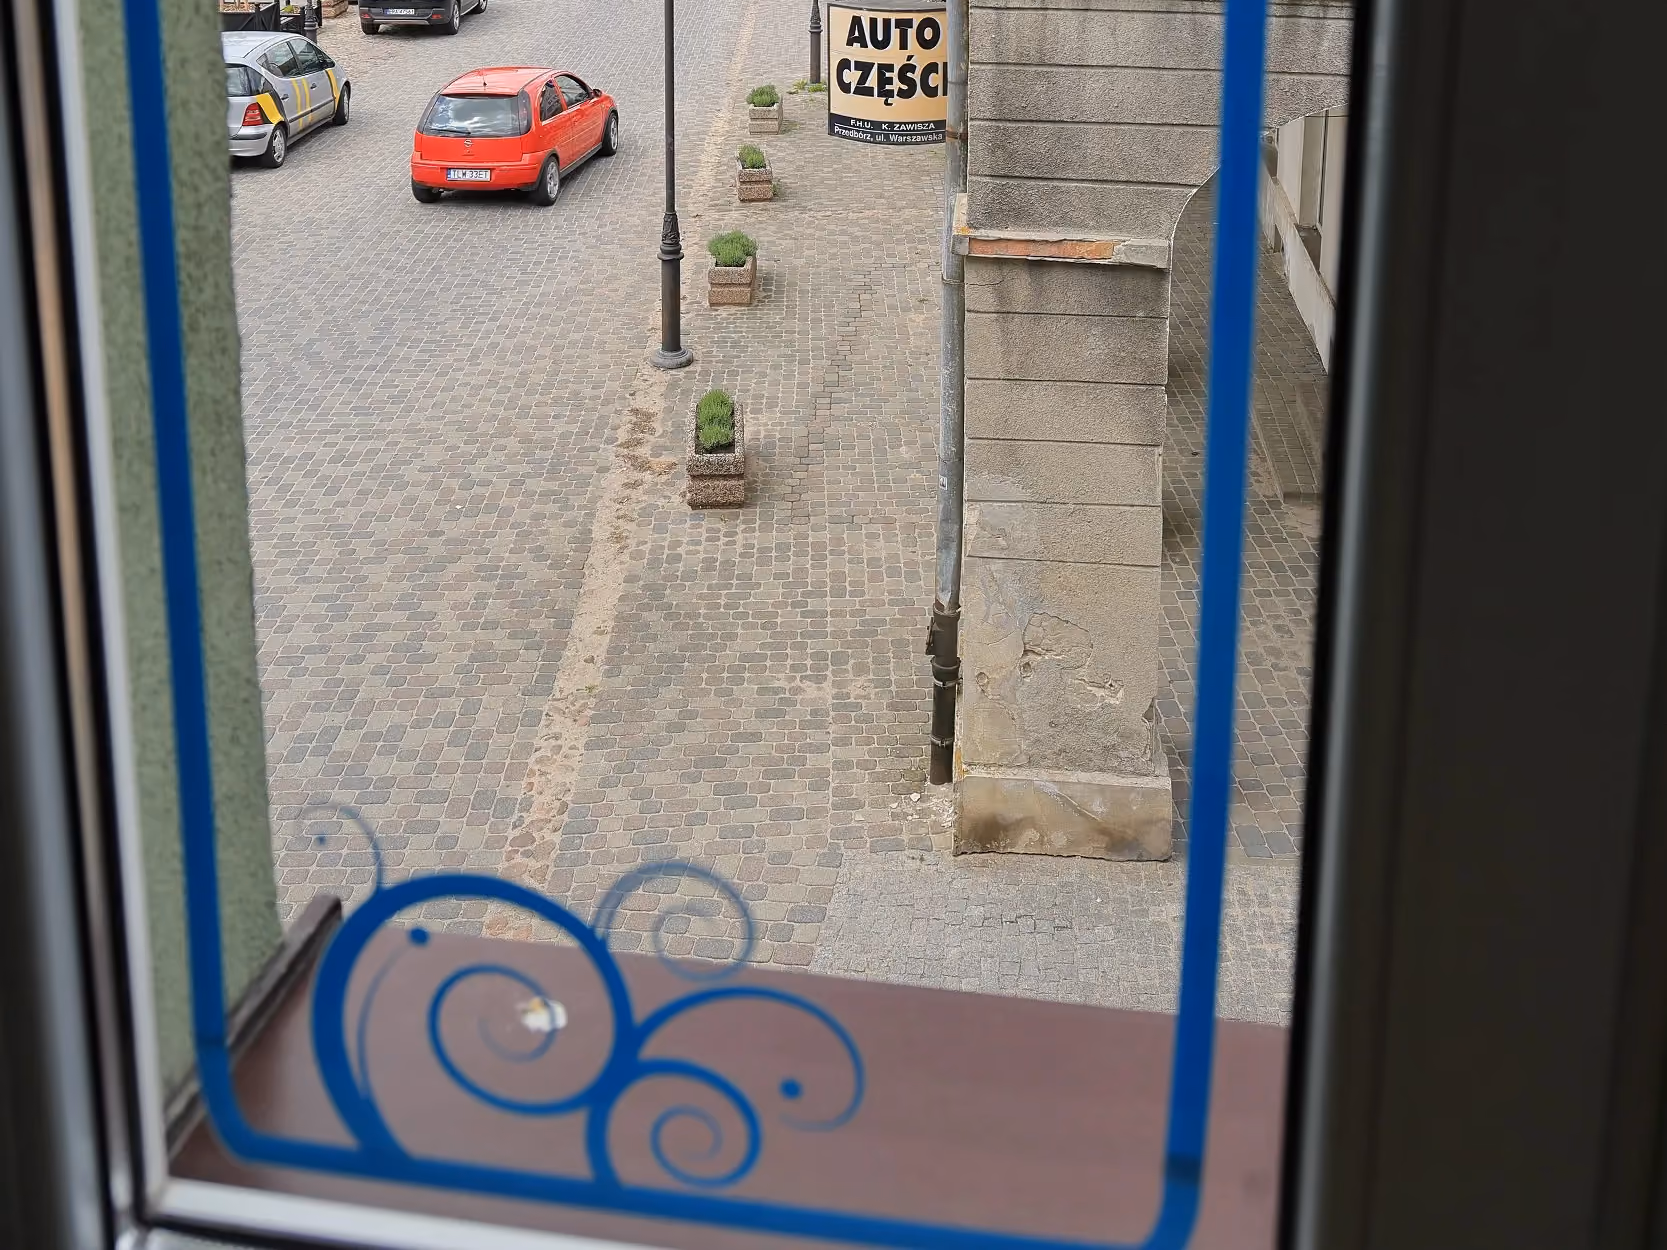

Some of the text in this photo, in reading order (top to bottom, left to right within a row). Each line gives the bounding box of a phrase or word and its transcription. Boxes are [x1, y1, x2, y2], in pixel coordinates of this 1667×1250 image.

[845, 14, 941, 51] AUTO
[850, 119, 873, 129] F.H.U.
[893, 123, 935, 131] ZAWISZA
[834, 126, 943, 142] Przedbórz, ul. Warszawska
